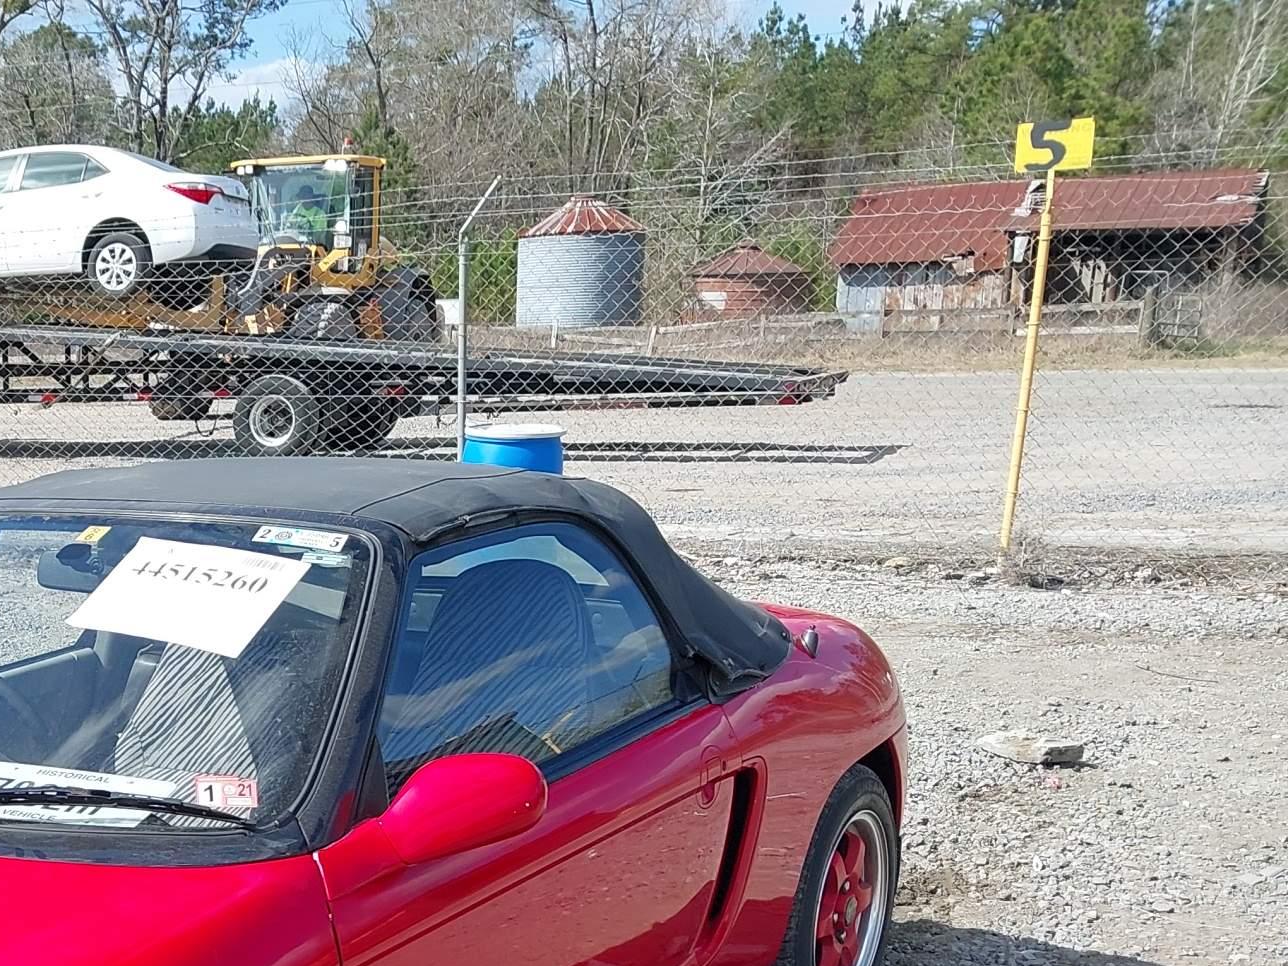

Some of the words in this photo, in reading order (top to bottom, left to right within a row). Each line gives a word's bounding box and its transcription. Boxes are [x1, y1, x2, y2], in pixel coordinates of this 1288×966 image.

[1024, 117, 1072, 171] 5
[258, 528, 271, 539] 2
[329, 536, 343, 548] 5
[131, 560, 268, 595] 44515260
[36, 768, 110, 784] HISTORICAL
[203, 784, 214, 802] 1
[238, 783, 252, 796] 21
[2, 808, 57, 822] VEHICLE
